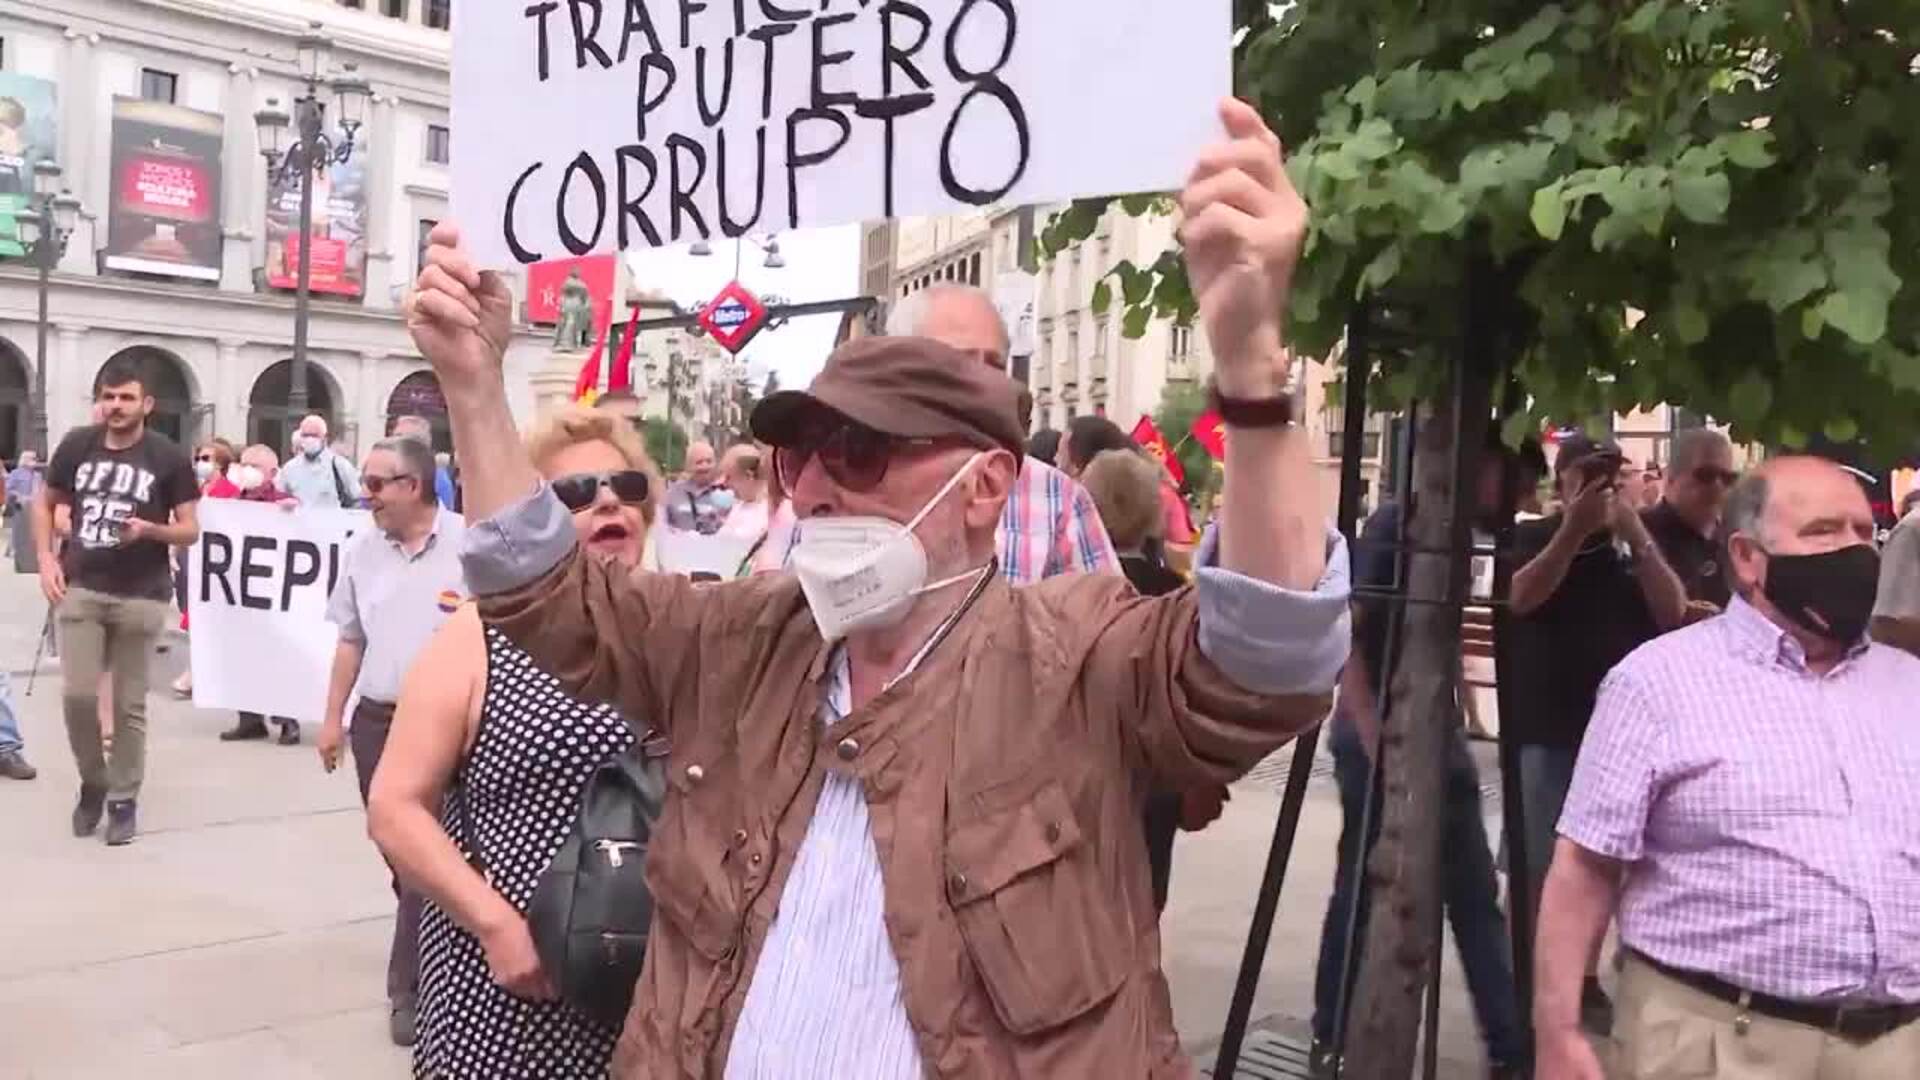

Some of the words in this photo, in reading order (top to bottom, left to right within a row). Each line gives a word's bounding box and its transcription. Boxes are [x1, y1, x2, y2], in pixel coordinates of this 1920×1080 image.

[638, 0, 1016, 141] PUTERO
[503, 76, 1030, 263] CORRUPTO
[75, 461, 155, 503] SFDK
